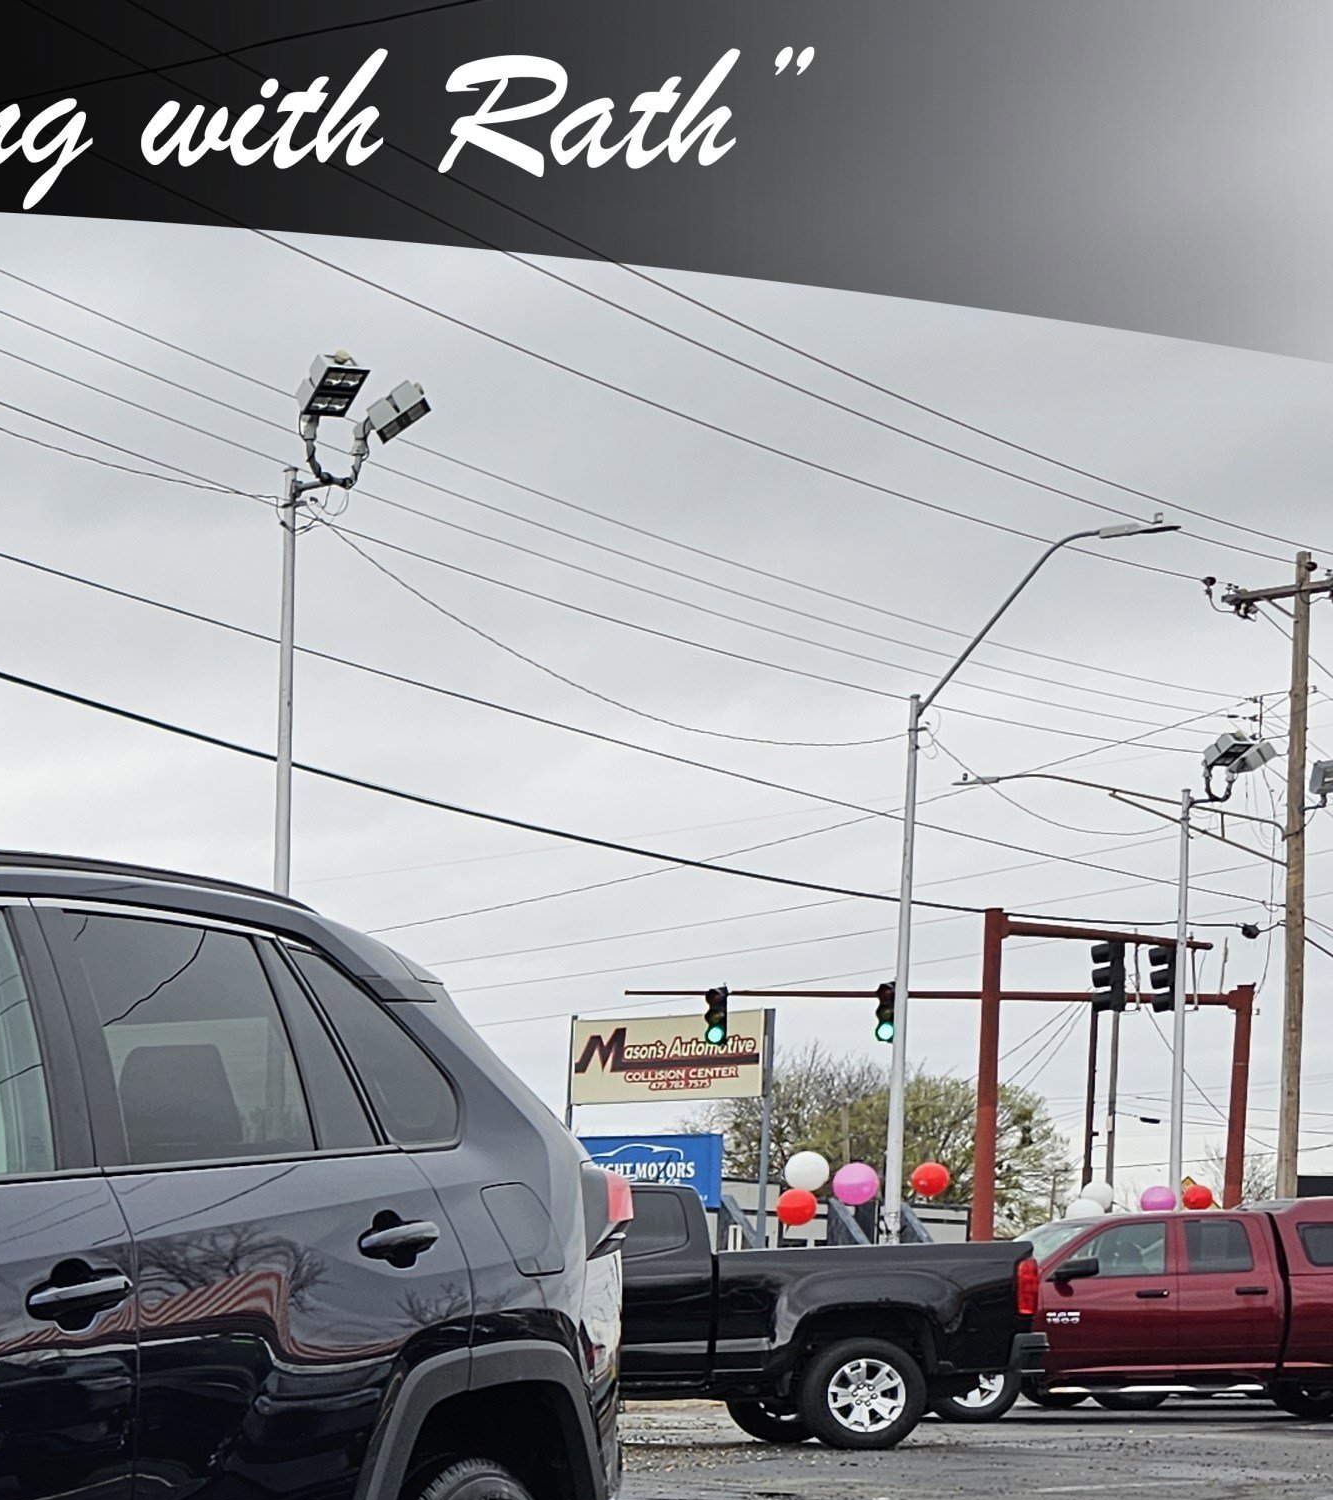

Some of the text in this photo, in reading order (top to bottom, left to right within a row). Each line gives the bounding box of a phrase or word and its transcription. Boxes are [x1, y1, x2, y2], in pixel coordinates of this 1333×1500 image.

[669, 1035, 755, 1058] Automotive
[625, 1066, 737, 1081] COLLISION CENTER
[636, 1162, 695, 1178] MOTORS
